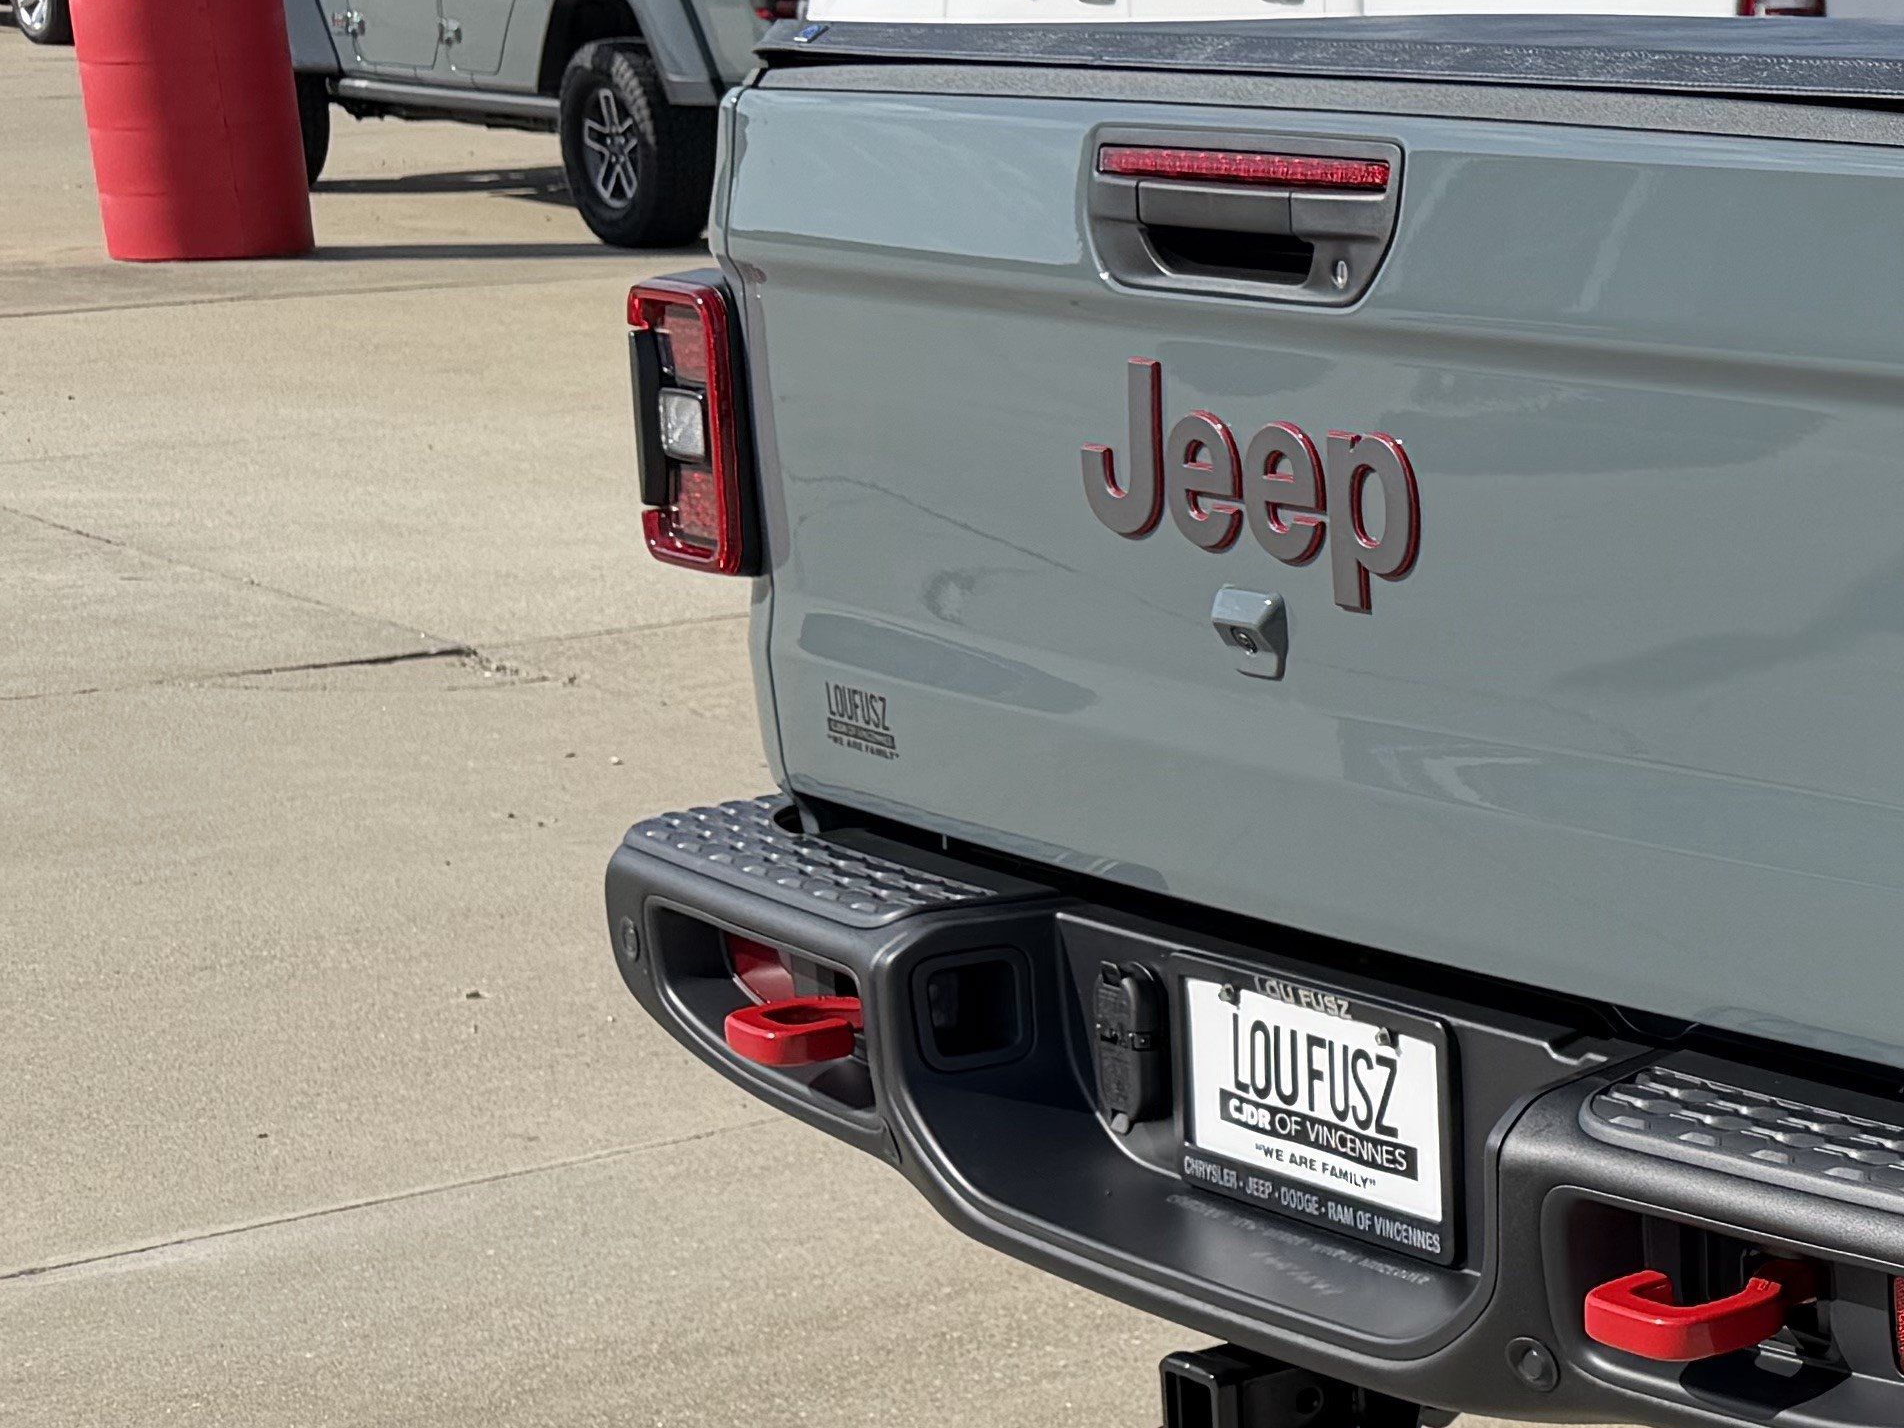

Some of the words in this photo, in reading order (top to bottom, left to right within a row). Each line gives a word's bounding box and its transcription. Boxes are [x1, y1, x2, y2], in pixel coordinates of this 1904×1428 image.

[1080, 354, 1422, 616] Jeep
[1253, 974, 1295, 1005] LOU
[1298, 988, 1353, 1021] FUSZ
[1231, 1011, 1299, 1107] LOU
[1305, 1032, 1399, 1139] FUSZ
[1228, 1098, 1272, 1131] CJDR
[1274, 1112, 1302, 1138] OF
[1306, 1120, 1408, 1171] VINCENNES
[1288, 1152, 1318, 1172] ARE
[1183, 1155, 1238, 1190] CHRYSLER
[1245, 1176, 1273, 1200] JEEP
[1280, 1185, 1320, 1216] DODGE
[1327, 1200, 1355, 1228] RAM
[1356, 1210, 1372, 1231] OF
[1373, 1214, 1441, 1254] VINCENNES
